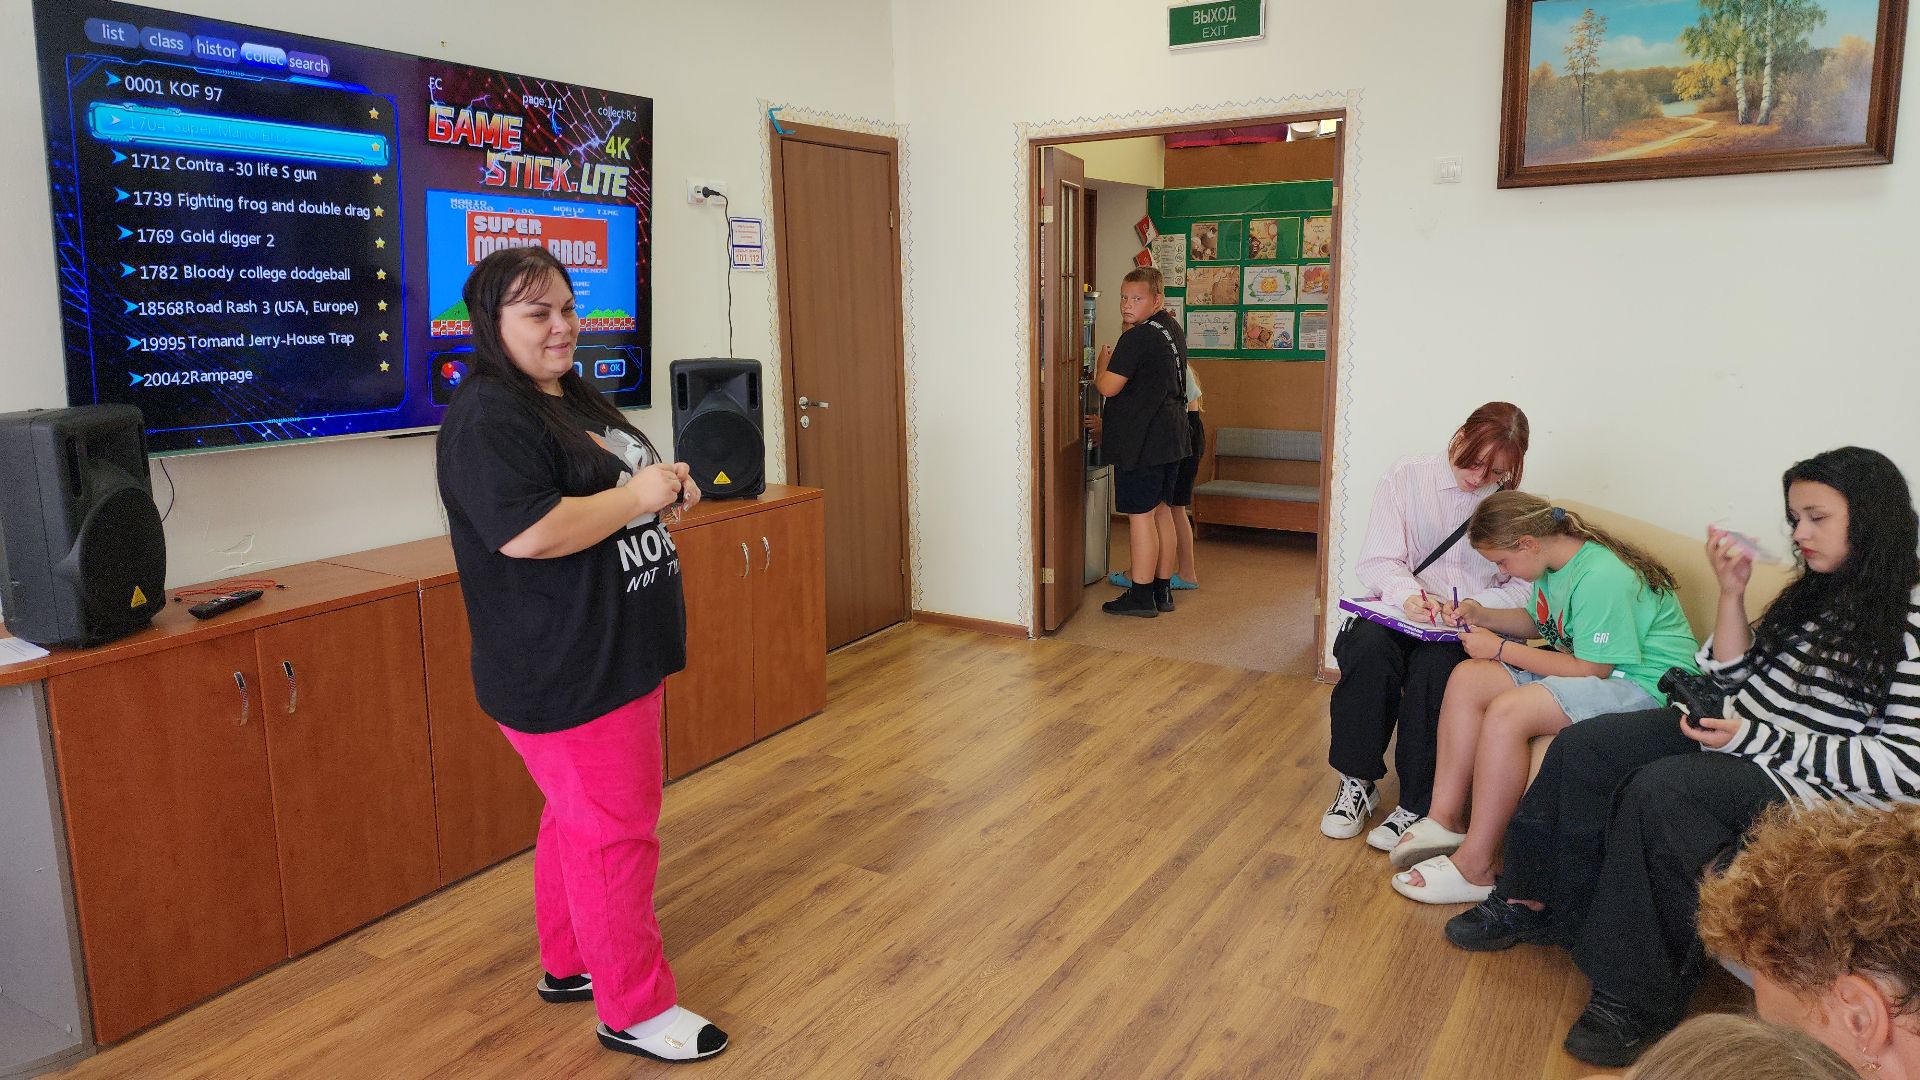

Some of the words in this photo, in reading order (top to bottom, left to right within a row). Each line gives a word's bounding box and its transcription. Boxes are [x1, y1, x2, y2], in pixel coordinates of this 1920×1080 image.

[1193, 6, 1236, 25] ВЫХОД
[1202, 25, 1228, 38] EXIT
[102, 24, 125, 41] list
[150, 34, 184, 51] class
[197, 39, 237, 59] histor
[289, 56, 329, 74] search
[125, 75, 164, 95] 0001
[170, 81, 200, 98] KOF
[205, 86, 222, 102] 97
[429, 77, 443, 91] FC
[428, 104, 523, 151] GAME
[606, 136, 631, 160] 4K
[131, 153, 170, 170] 1712
[176, 157, 224, 173] Contra
[228, 162, 253, 177] -30
[257, 160, 278, 177] life
[282, 166, 290, 179] S
[294, 169, 317, 182] gun
[133, 191, 172, 207] 1739
[178, 193, 234, 212] Fighting
[238, 196, 268, 214] frog
[271, 198, 295, 213] and
[298, 200, 341, 216] double
[345, 203, 371, 221] drag
[597, 208, 619, 216] TIME
[473, 215, 542, 235] SUPER
[137, 228, 174, 244] 1769
[181, 229, 215, 244] Gold
[219, 230, 262, 248] digger
[266, 234, 275, 247] 2
[548, 239, 603, 266] BROS.
[140, 265, 178, 280] 1782
[184, 265, 234, 282] Bloody
[239, 266, 287, 282] college
[290, 266, 351, 283] dodgeball
[226, 300, 258, 314] Rash
[262, 301, 271, 314] 3
[274, 301, 309, 316] (USA,
[313, 300, 359, 315] Europe)
[140, 336, 186, 351] 19995
[188, 334, 244, 348] Tomand
[249, 332, 325, 349] Jerry-House
[329, 332, 355, 346] Trap
[626, 566, 660, 592] NOT
